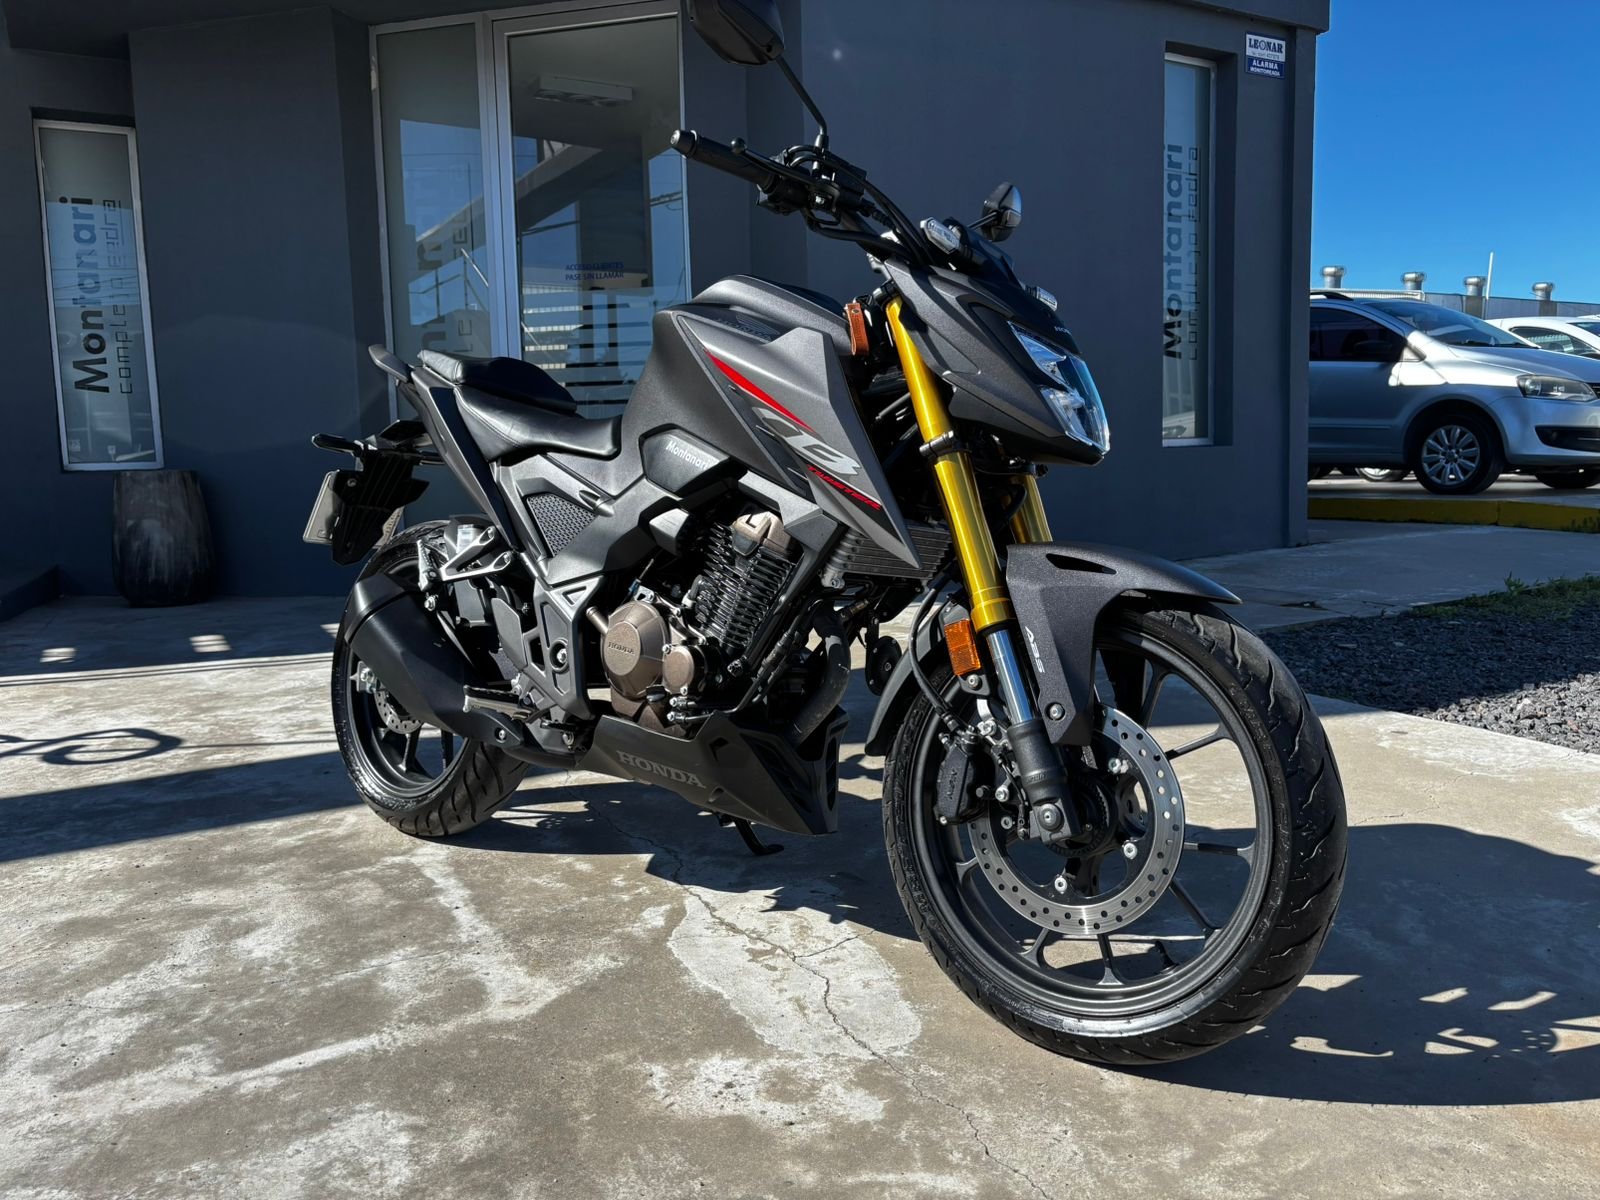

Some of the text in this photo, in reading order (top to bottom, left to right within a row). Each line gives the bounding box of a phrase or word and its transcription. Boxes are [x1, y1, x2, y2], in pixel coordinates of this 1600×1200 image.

[1248, 38, 1283, 53] LEONAR
[1252, 59, 1279, 70] ALARMA
[1164, 143, 1183, 360] Montanari
[59, 196, 110, 394] Montanari
[665, 440, 710, 470] Montanari
[608, 641, 635, 655] HONDA
[1024, 626, 1046, 673] ABS
[616, 750, 707, 789] HONDA
